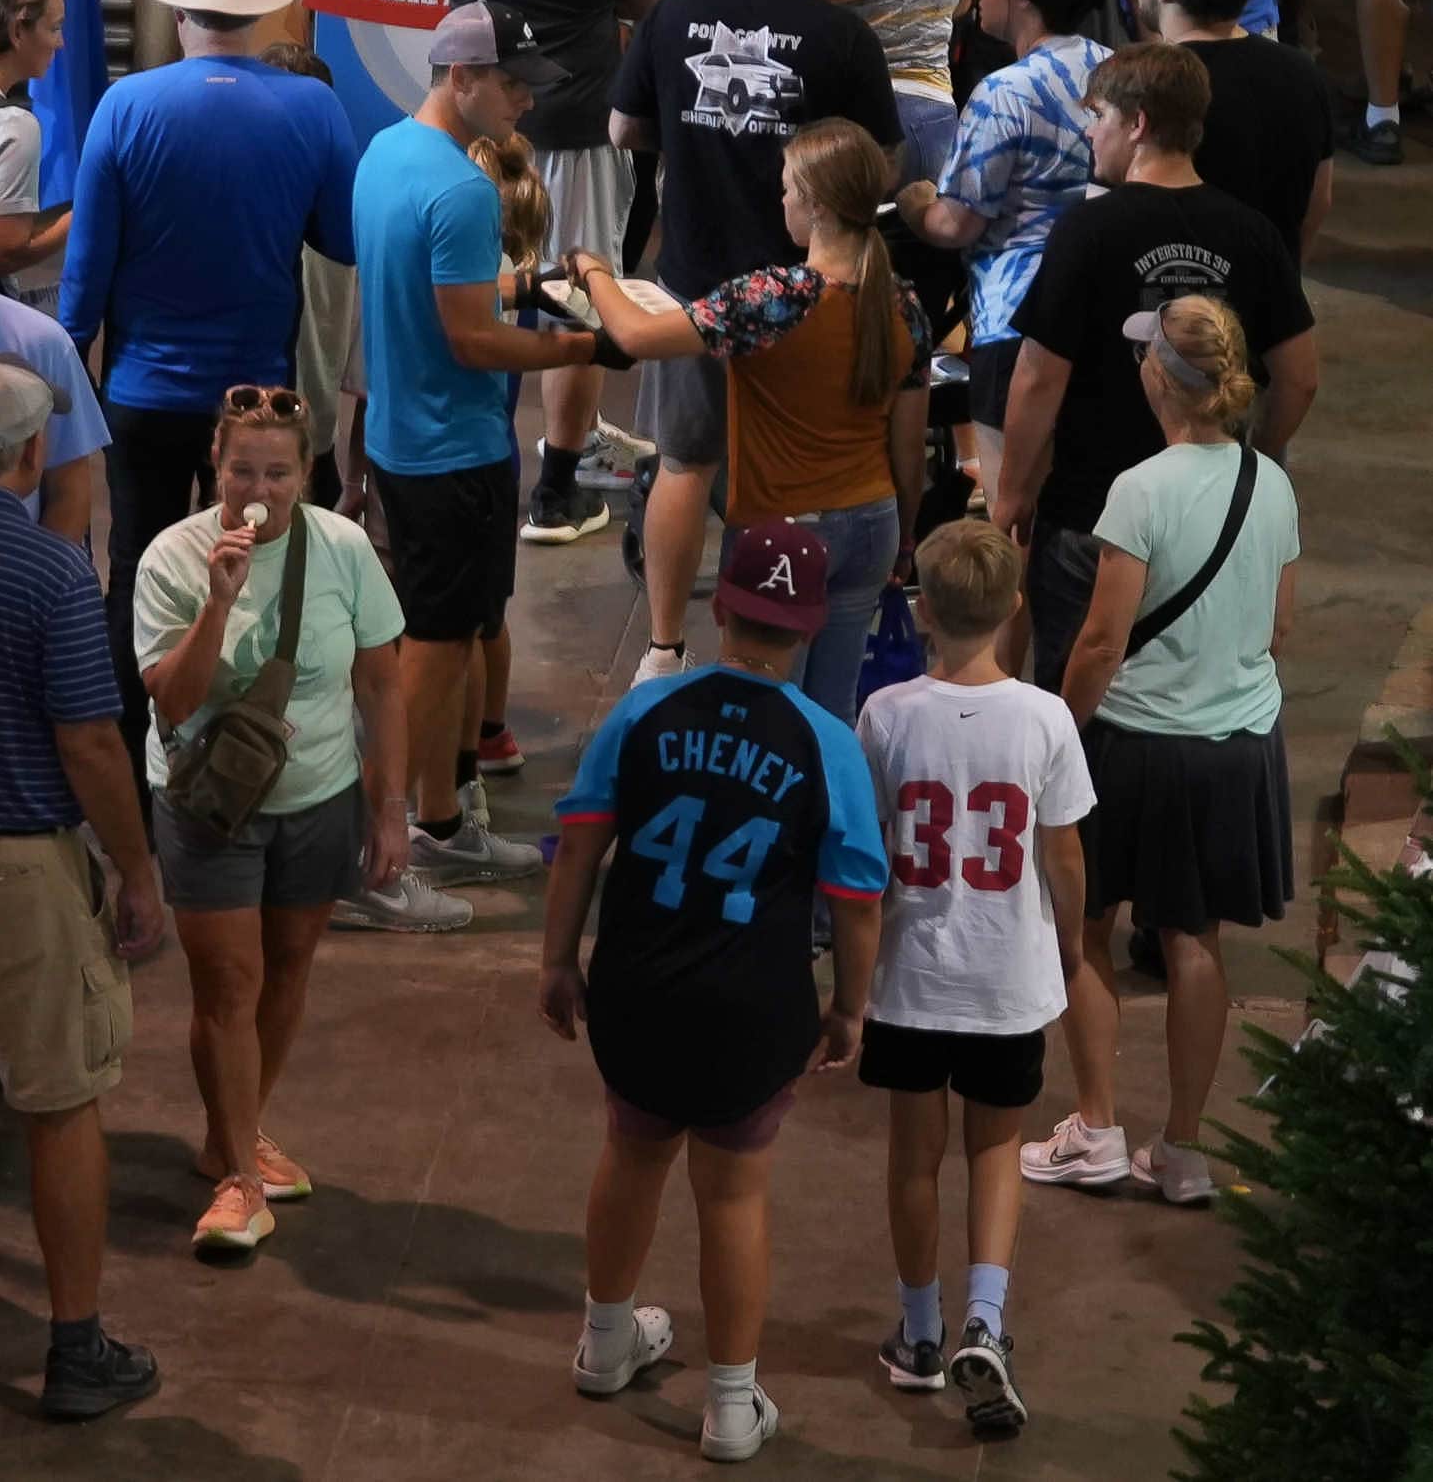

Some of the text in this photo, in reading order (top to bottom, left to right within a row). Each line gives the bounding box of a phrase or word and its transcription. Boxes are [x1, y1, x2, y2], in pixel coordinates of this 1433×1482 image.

[1134, 244, 1211, 275] INTERSTATE
[757, 553, 796, 596] A
[658, 730, 804, 803] CHENEY
[630, 794, 781, 924] 44
[893, 780, 1029, 891] 33
